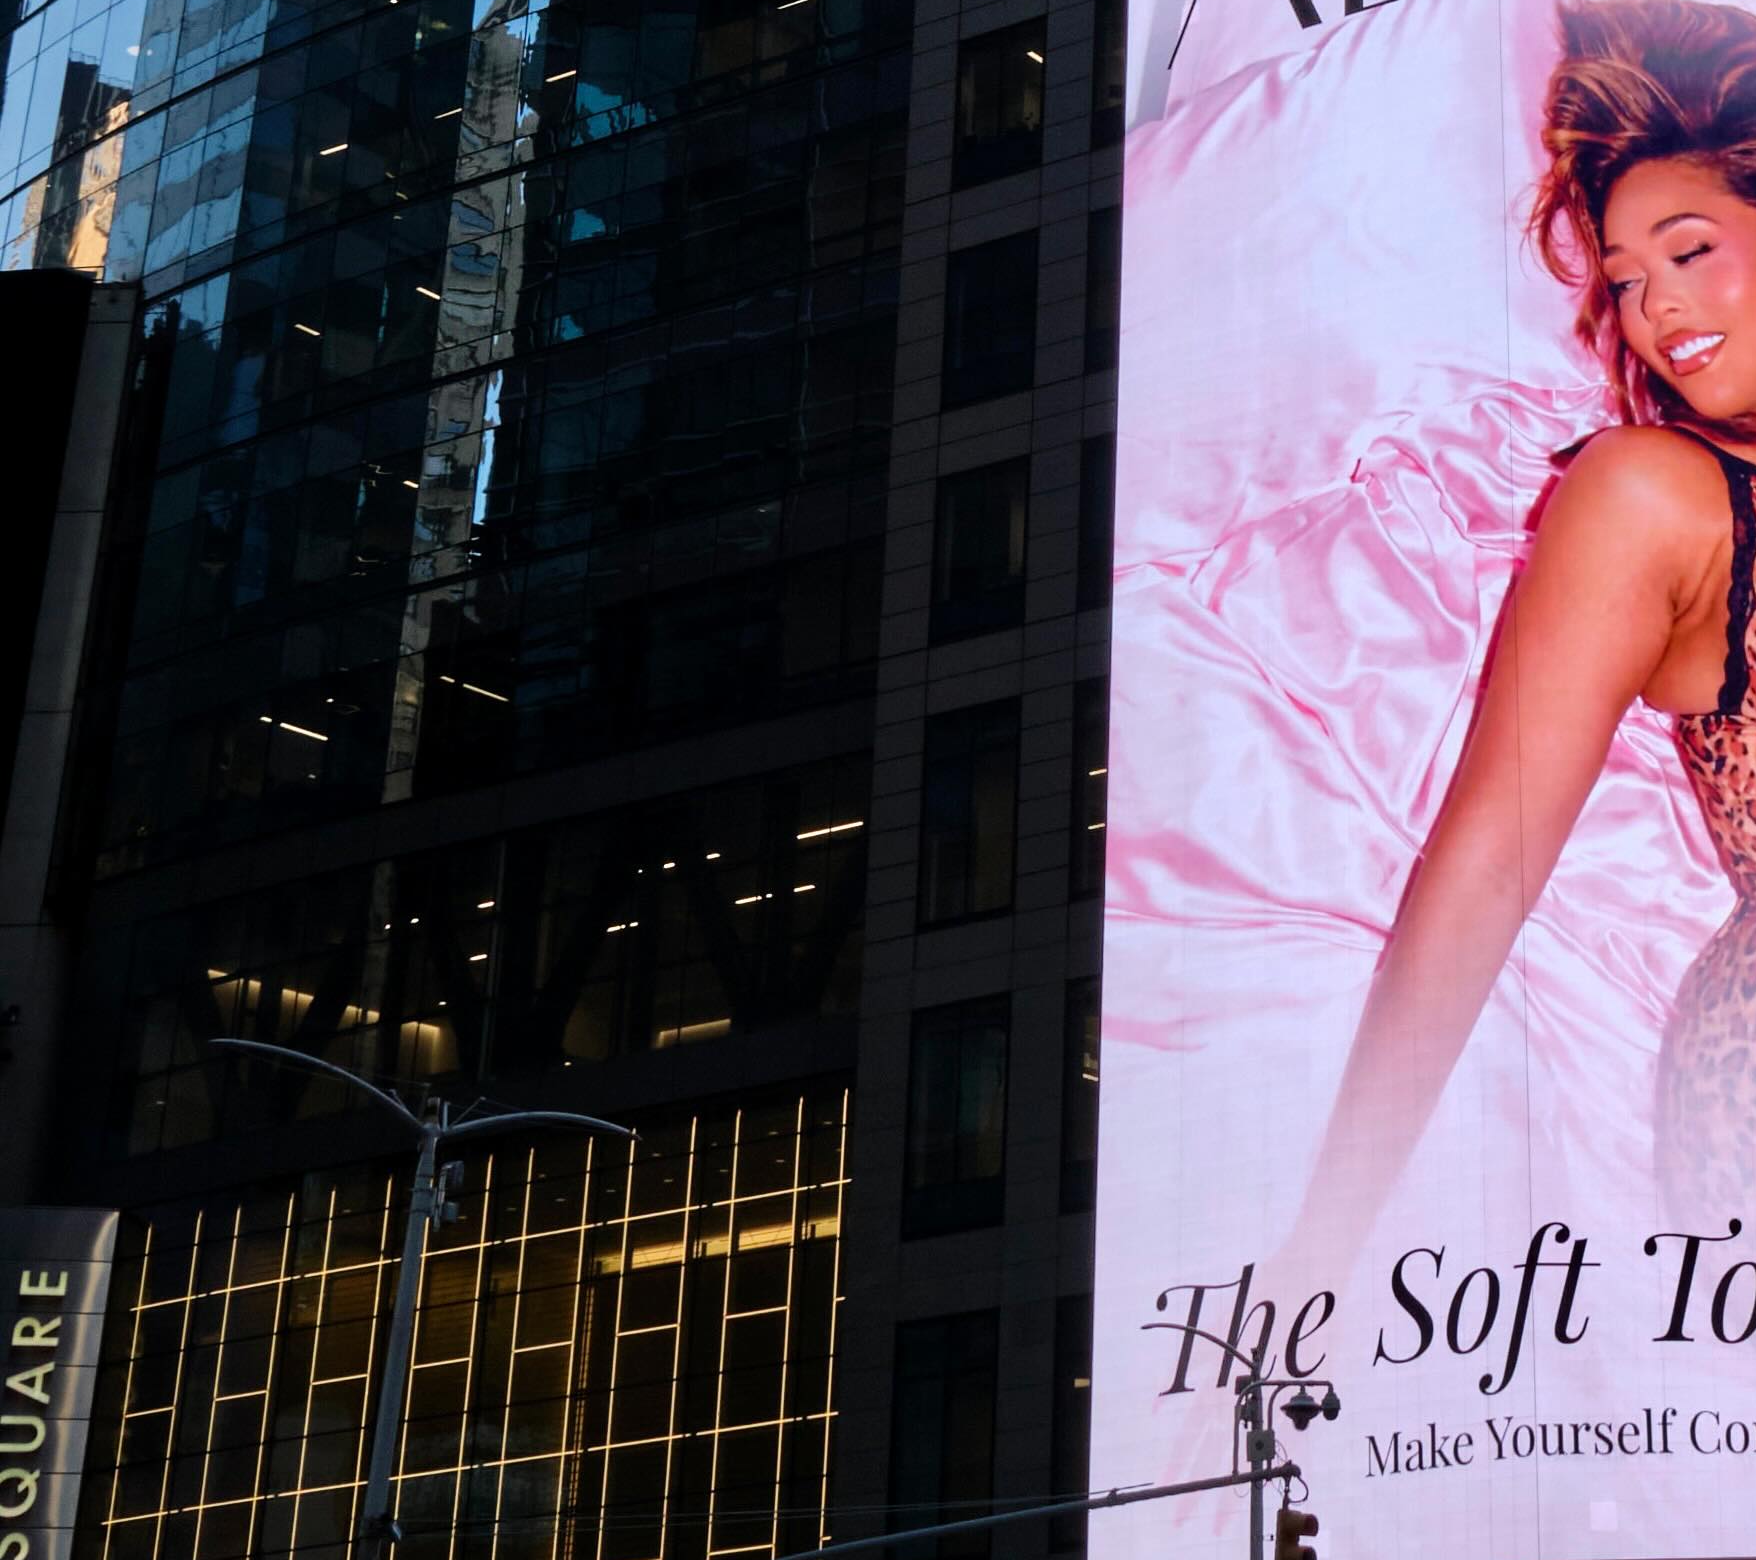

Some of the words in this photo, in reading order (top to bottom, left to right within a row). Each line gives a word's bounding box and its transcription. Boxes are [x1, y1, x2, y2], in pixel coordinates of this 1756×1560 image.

[1156, 1262, 1336, 1397] The
[1372, 1220, 1602, 1397] Soft
[1364, 1428, 1475, 1480] Make
[1489, 1406, 1677, 1462] Yourself
